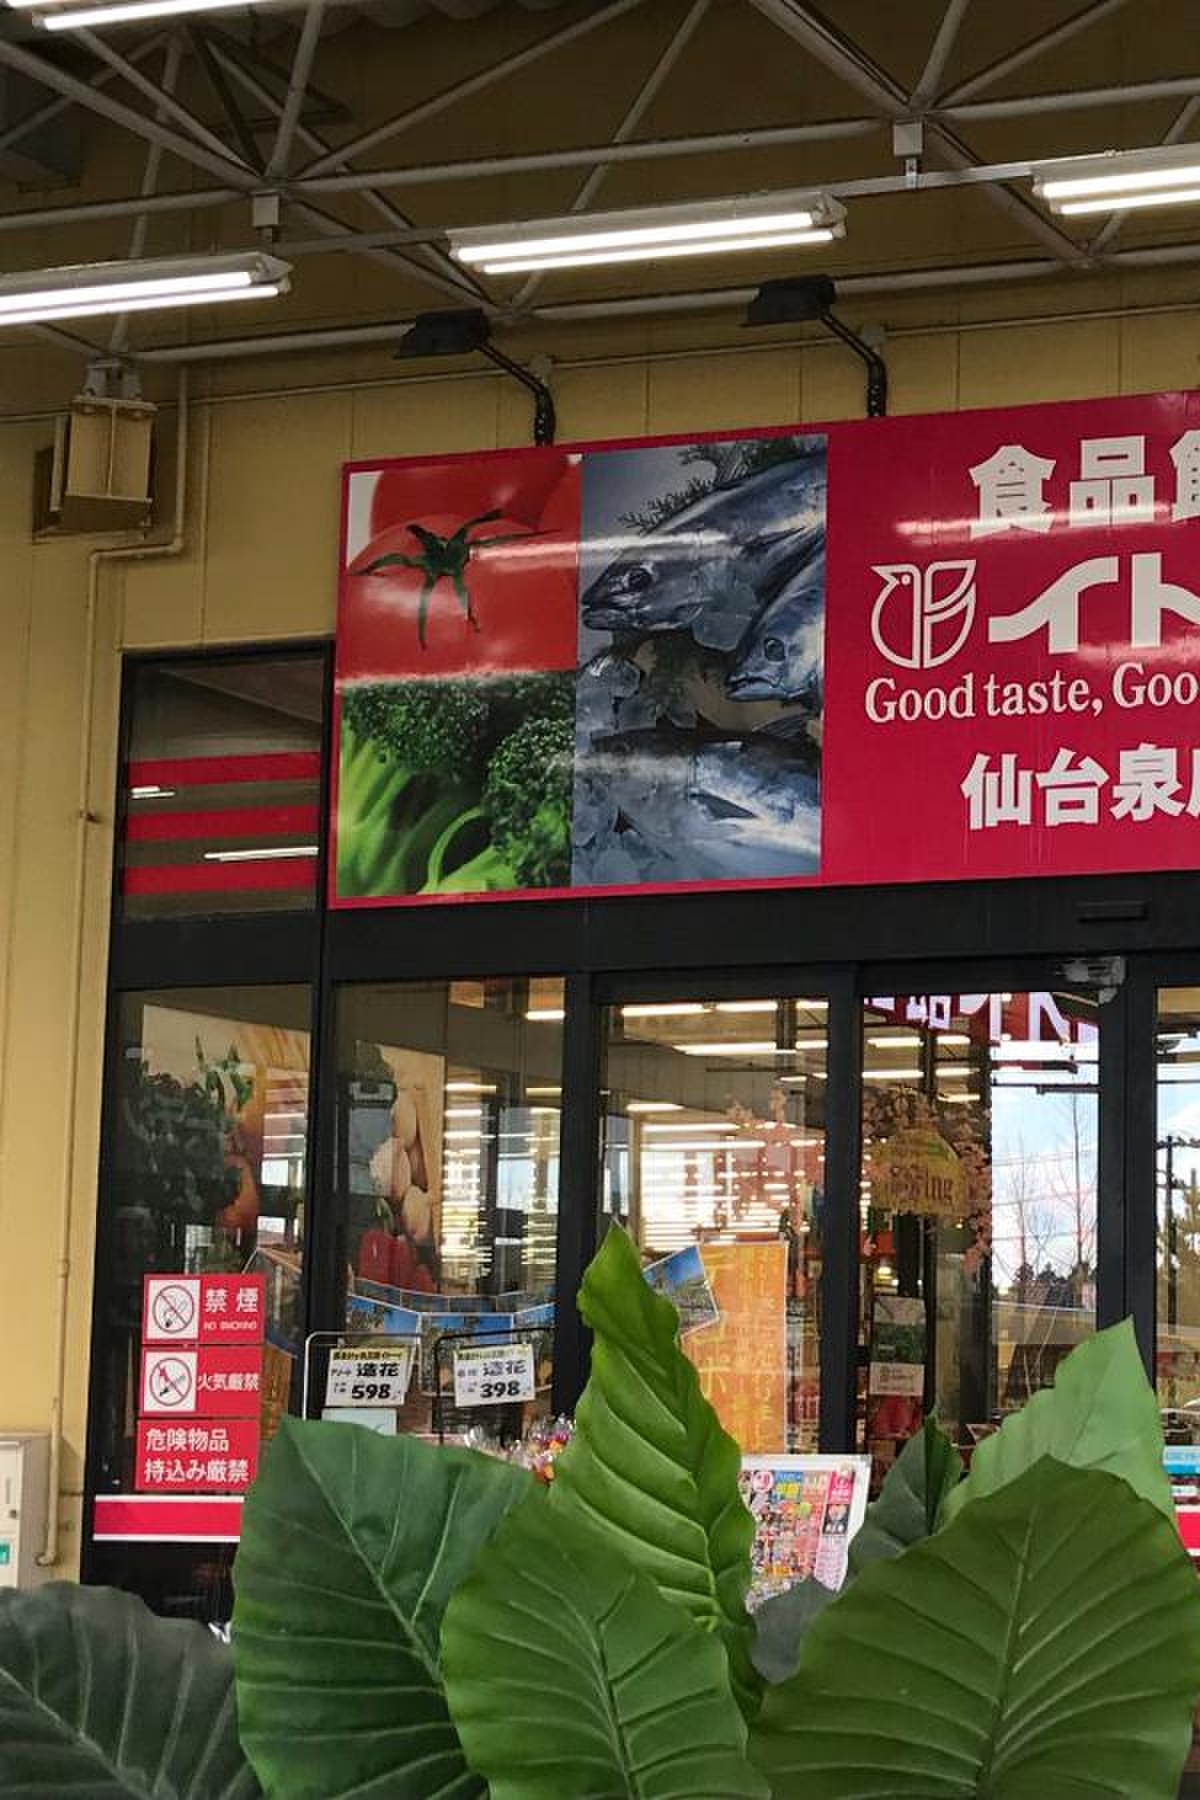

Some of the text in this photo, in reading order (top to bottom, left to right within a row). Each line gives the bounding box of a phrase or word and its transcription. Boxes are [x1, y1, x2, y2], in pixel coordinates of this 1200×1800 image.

[865, 672, 974, 723] Good
[985, 668, 1103, 718] taste,
[205, 1288, 258, 1313] 禁煙
[197, 1372, 259, 1392] 火気厳禁
[352, 1383, 391, 1399] 598
[480, 1380, 521, 1398] 398
[145, 1428, 230, 1453] 危険物品
[144, 1460, 249, 1483] 持込み厳禁
